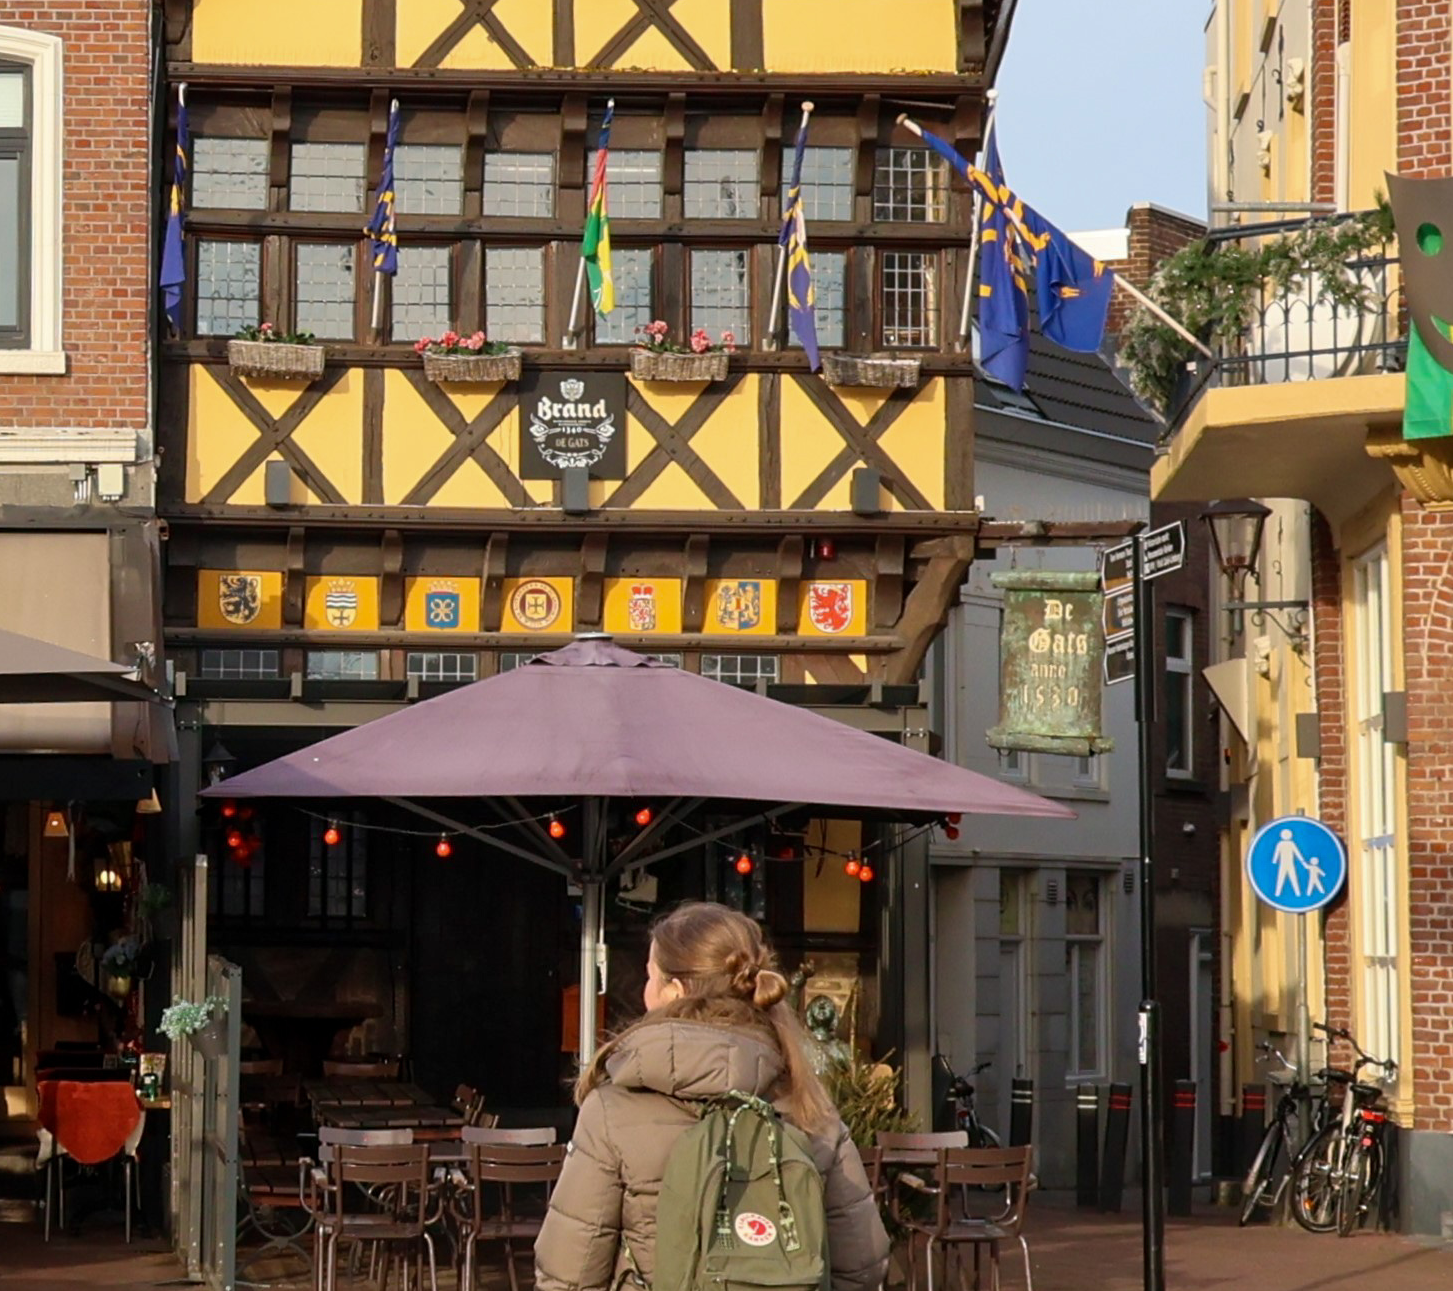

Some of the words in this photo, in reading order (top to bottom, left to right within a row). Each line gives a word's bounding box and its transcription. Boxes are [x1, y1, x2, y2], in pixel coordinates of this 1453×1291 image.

[537, 396, 607, 421] Brand
[568, 437, 589, 448] GATS
[1044, 599, 1073, 621] De
[1028, 628, 1088, 655] Gats
[1031, 663, 1066, 678] anno
